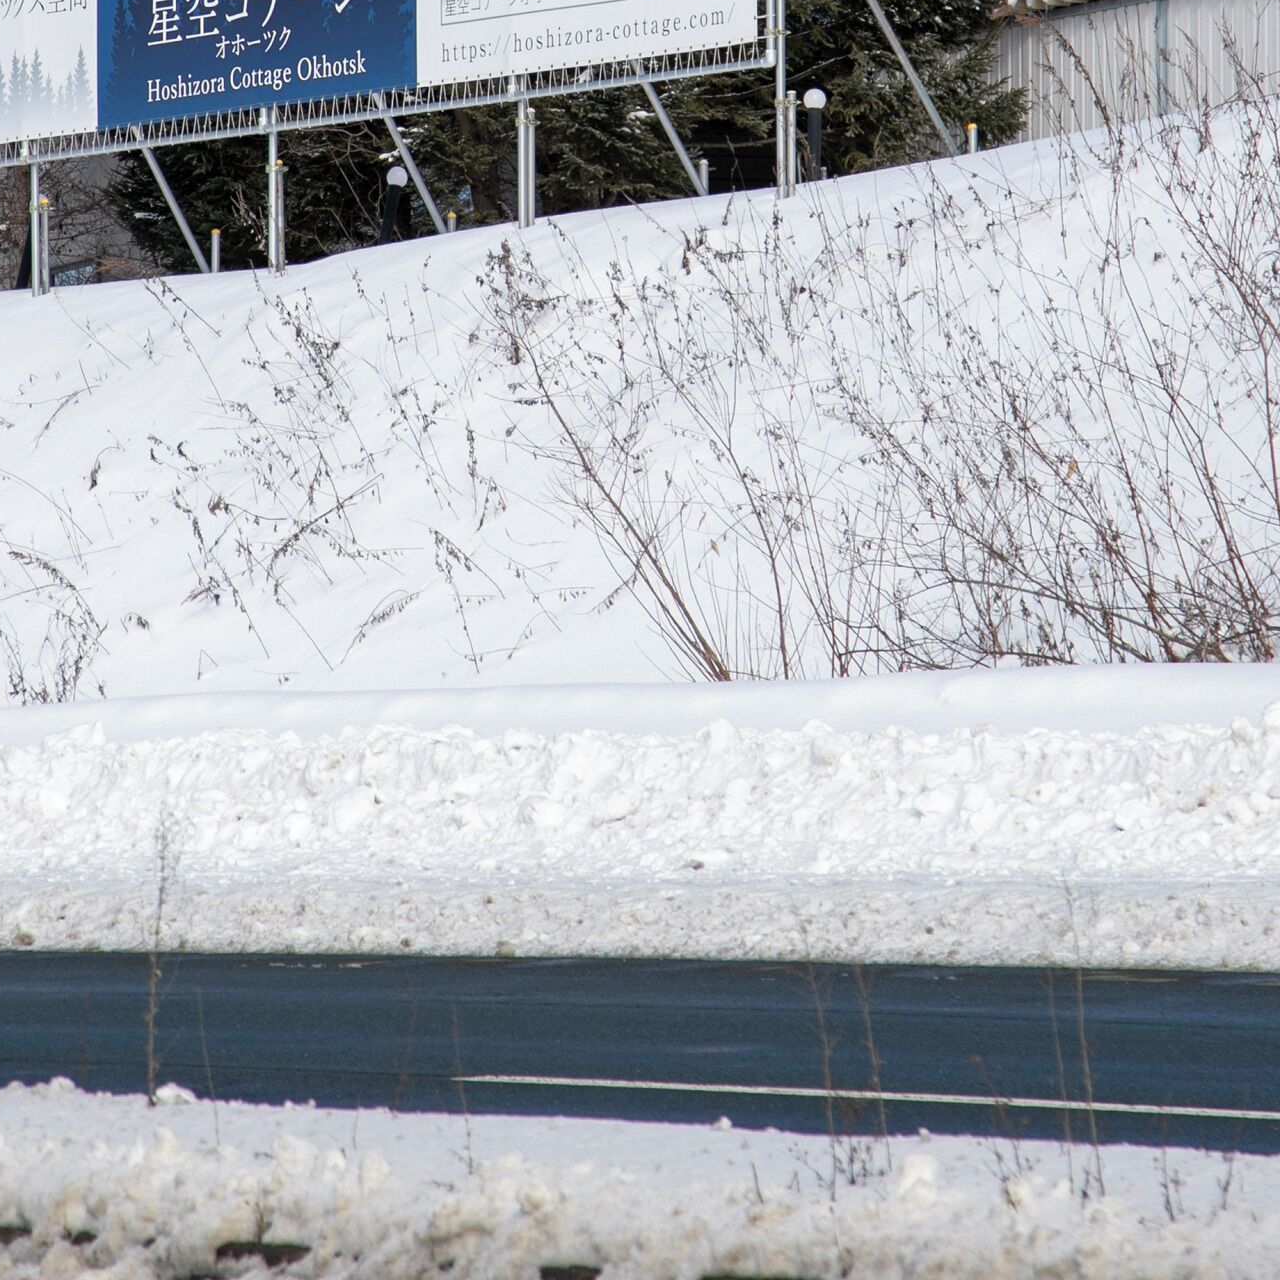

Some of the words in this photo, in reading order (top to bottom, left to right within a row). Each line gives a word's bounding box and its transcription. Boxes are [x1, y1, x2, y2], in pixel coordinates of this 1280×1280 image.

[215, 26, 292, 60] オホーツク
[441, 1, 736, 63] https://hoshizora-cottage.com/
[147, 74, 225, 103] Hoshizora
[229, 63, 292, 91] Cottage
[297, 49, 367, 81] Okhotsk
